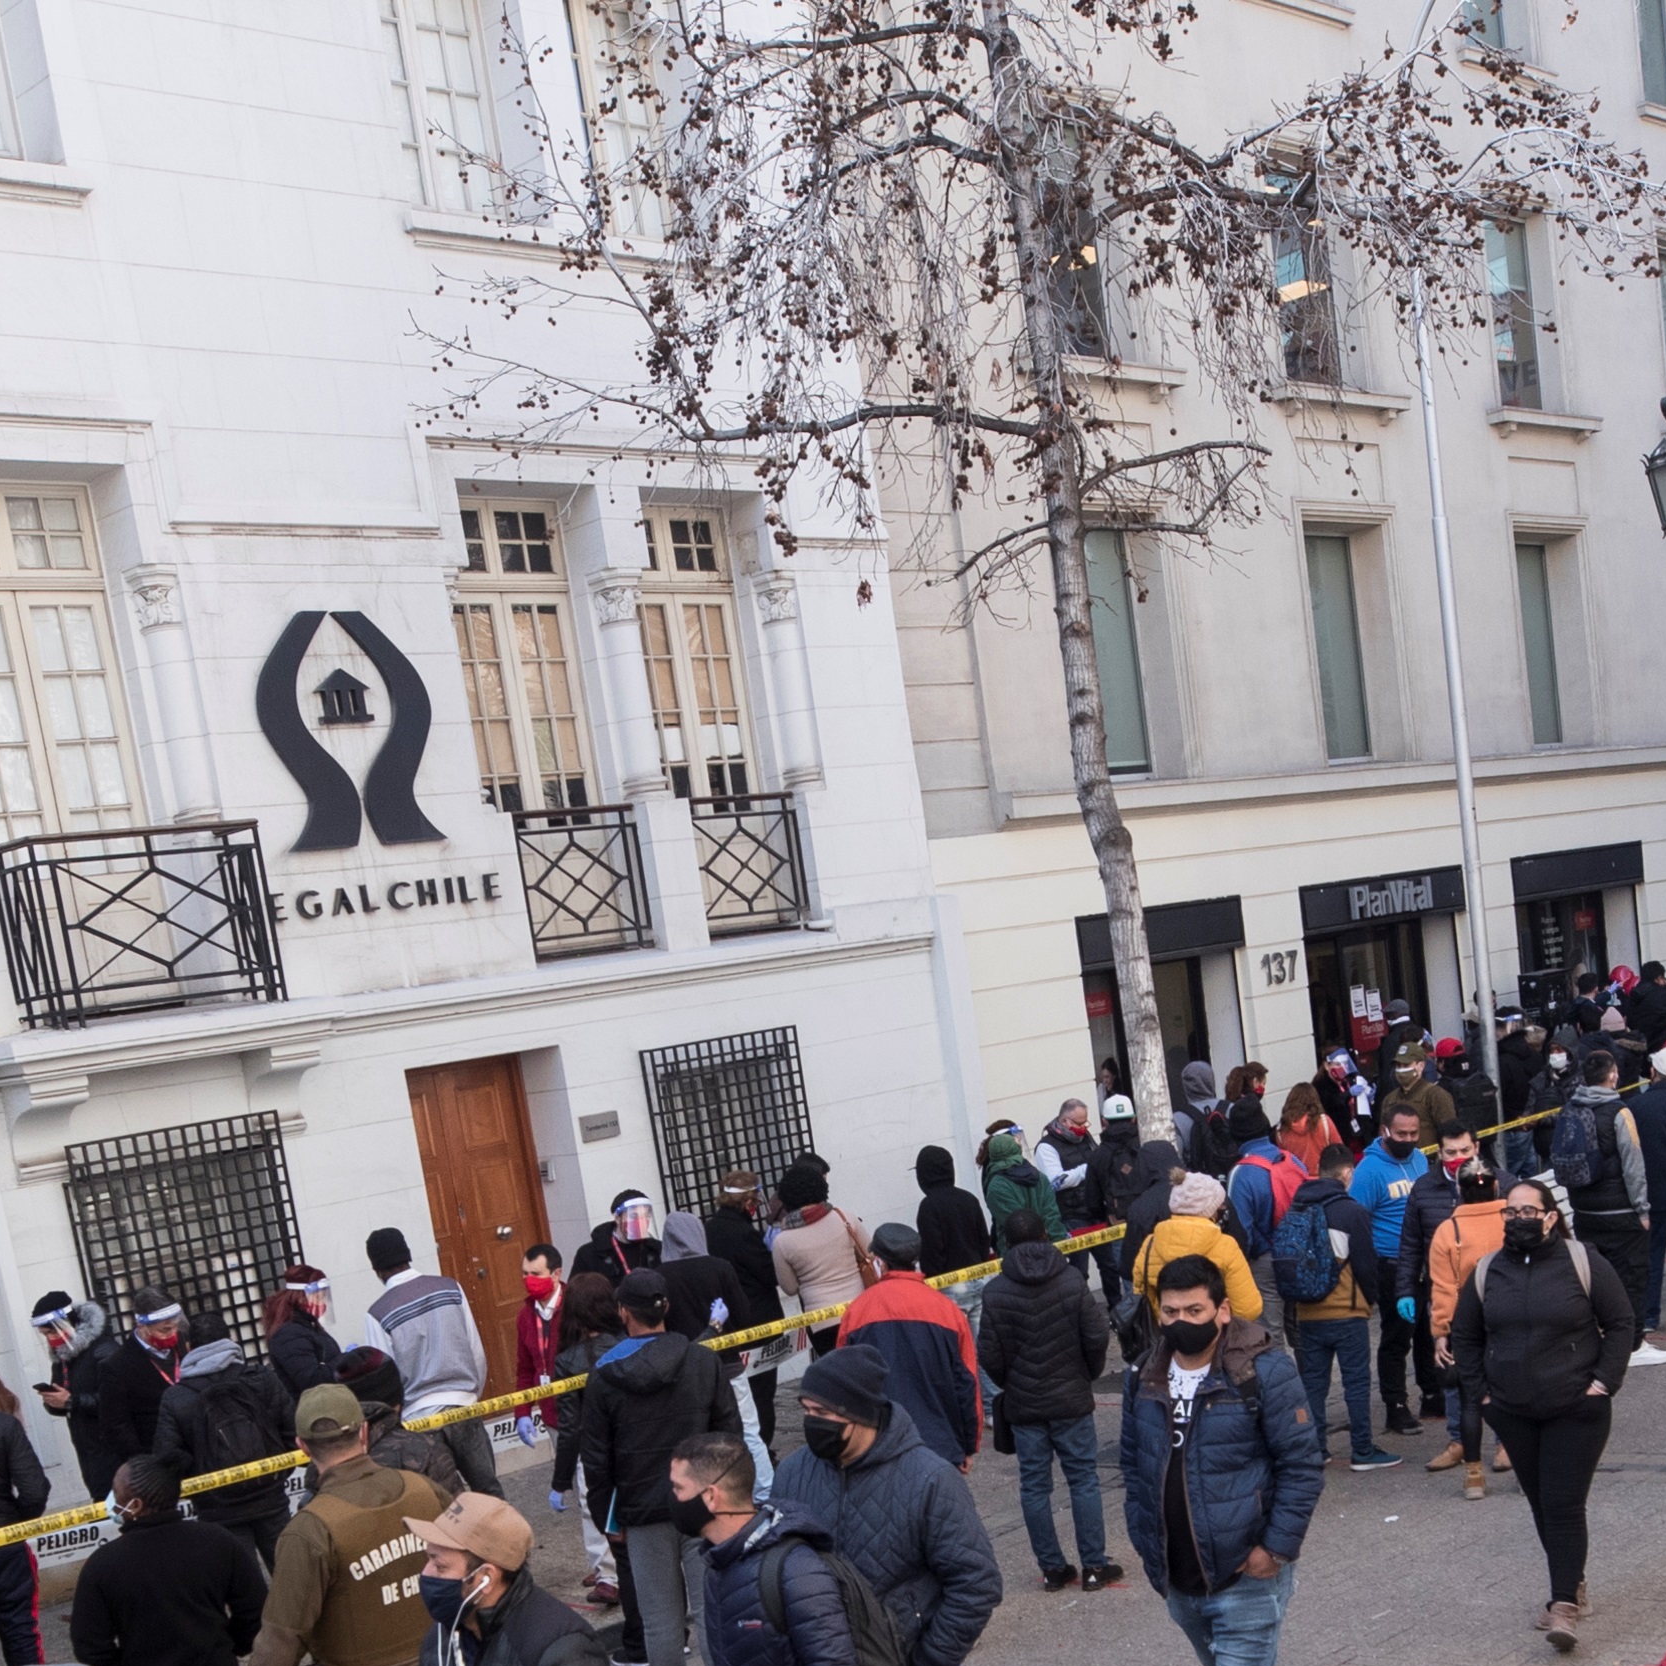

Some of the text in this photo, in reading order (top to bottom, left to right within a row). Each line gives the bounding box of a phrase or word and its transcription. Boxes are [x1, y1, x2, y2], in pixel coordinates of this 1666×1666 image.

[269, 872, 502, 920] EGALCHILE
[1348, 875, 1433, 920] PlanVital
[1260, 950, 1298, 987] 137
[37, 1526, 99, 1552] PELIGRO
[349, 1533, 428, 1580] CARABINE
[381, 1582, 400, 1605] DE
